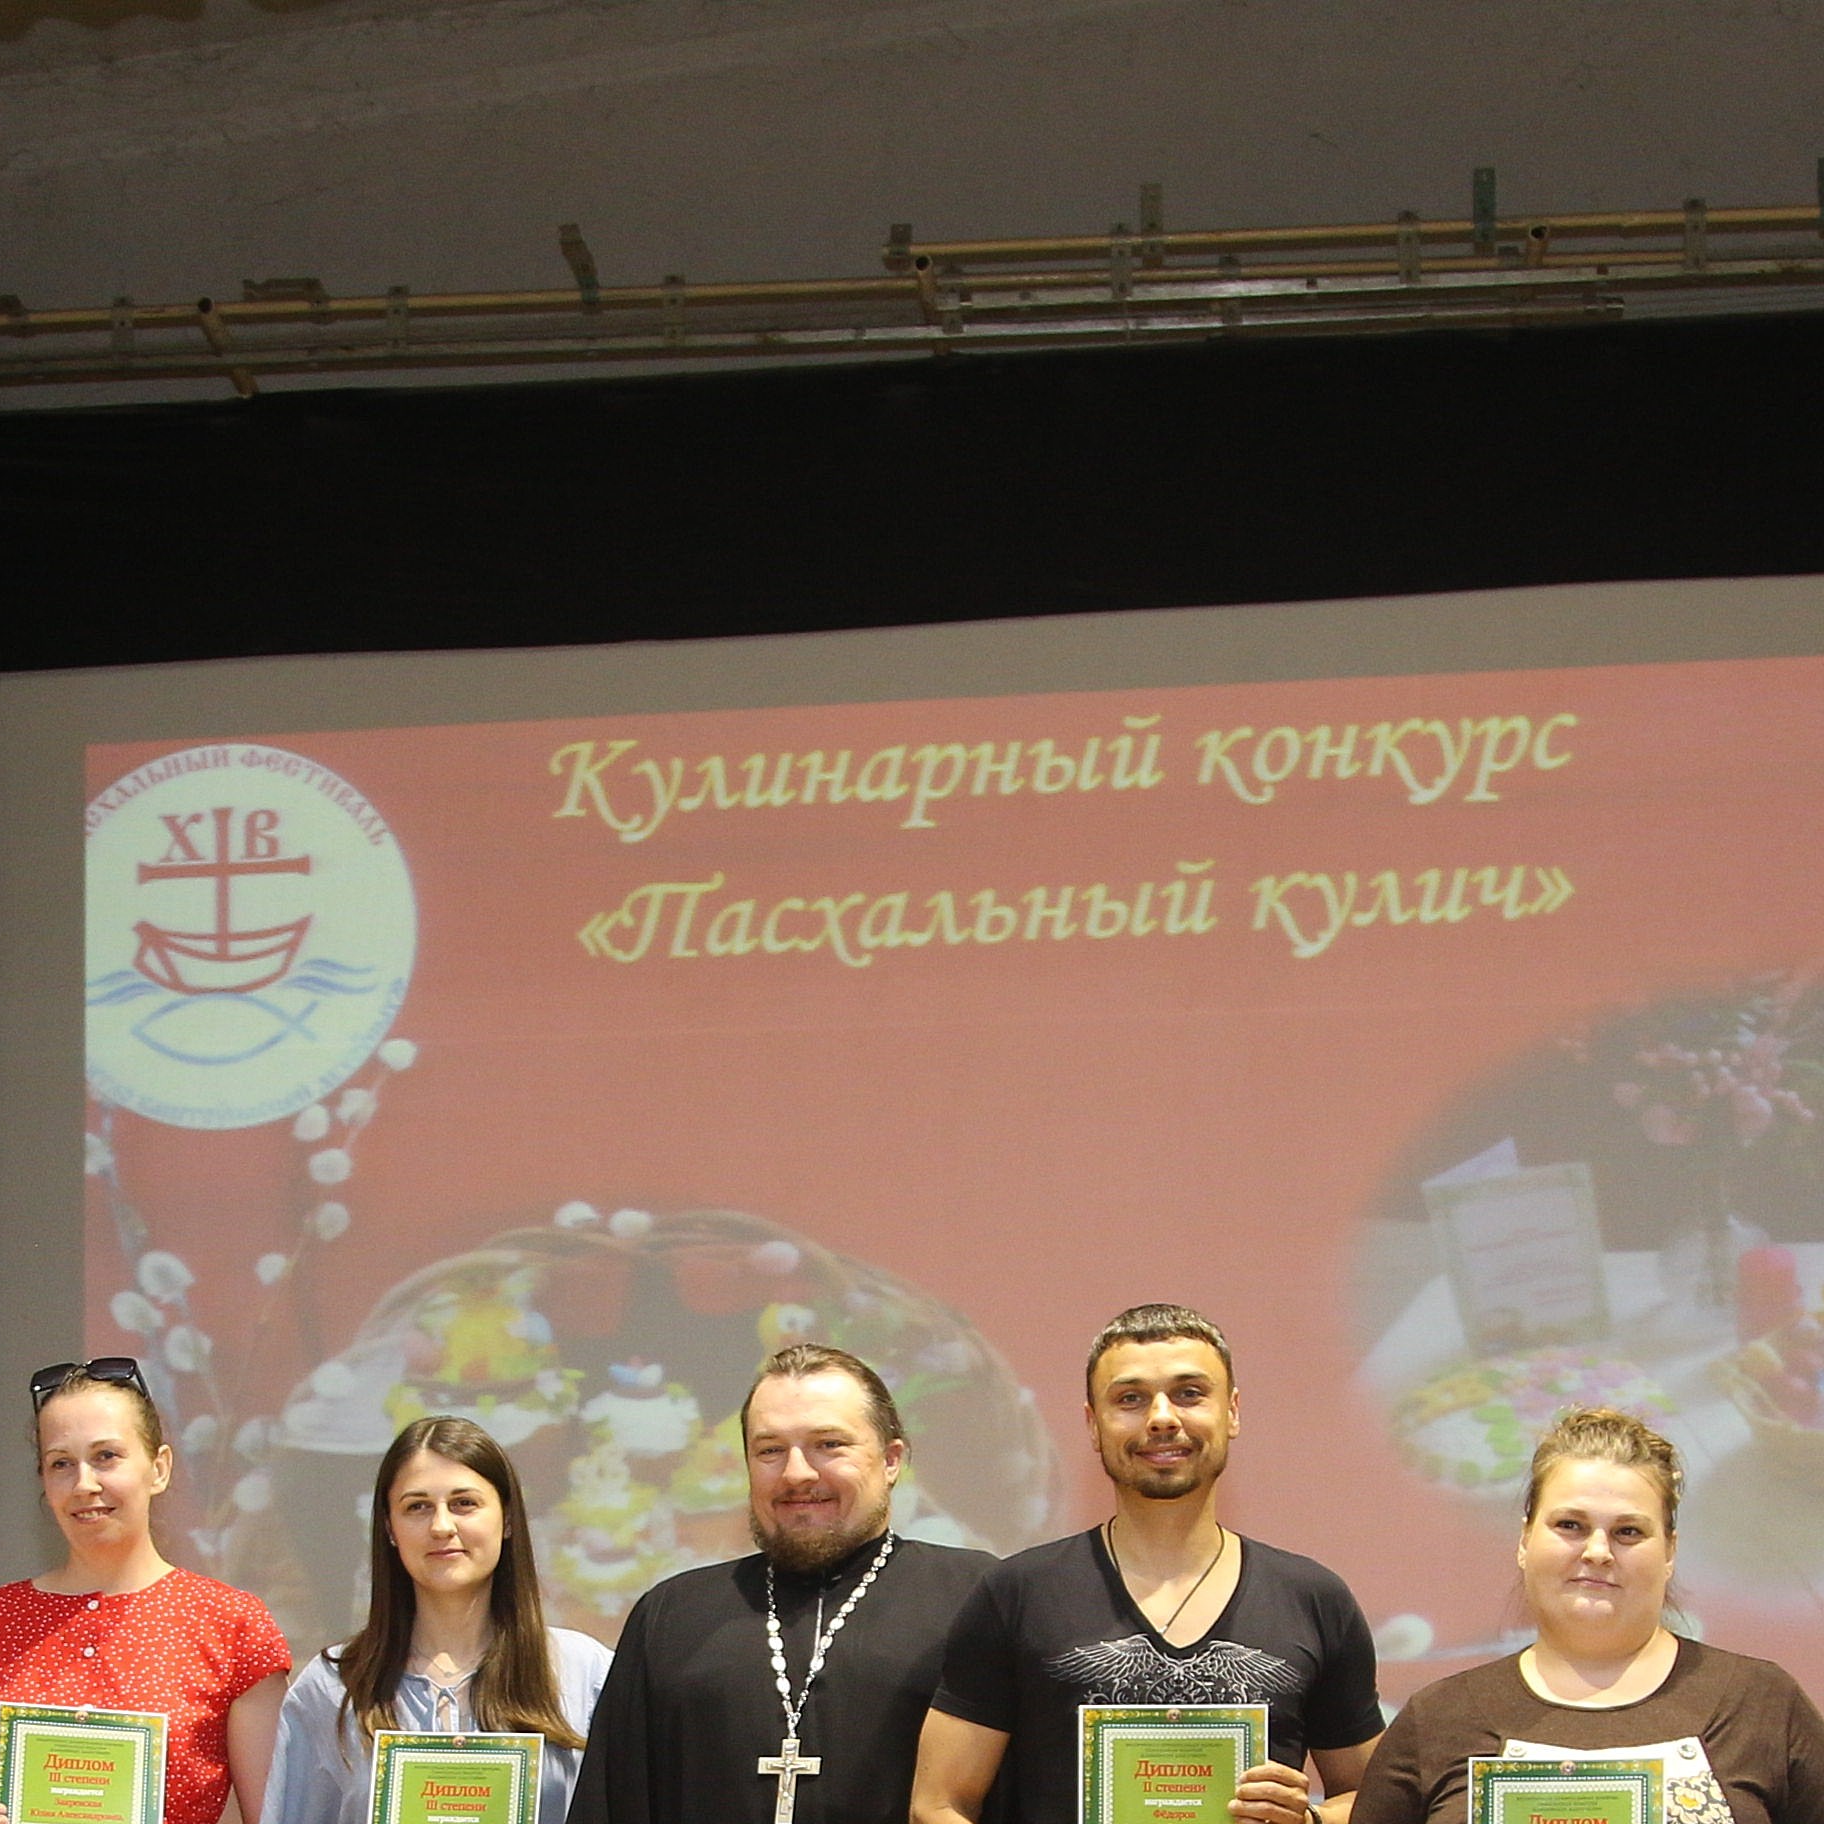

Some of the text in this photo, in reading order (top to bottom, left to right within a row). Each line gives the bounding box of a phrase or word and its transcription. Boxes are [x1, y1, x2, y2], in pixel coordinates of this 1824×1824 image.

[549, 713, 1578, 843] Кулинарный конкурс
[578, 859, 1575, 968] «Пасхальный кулич»
[43, 1754, 115, 1773] Диплом
[1134, 1761, 1213, 1780] Диплом
[48, 1774, 110, 1785] III степени
[1143, 1782, 1206, 1794] II степени
[420, 1782, 491, 1798] Диплом
[441, 1801, 487, 1812] степени
